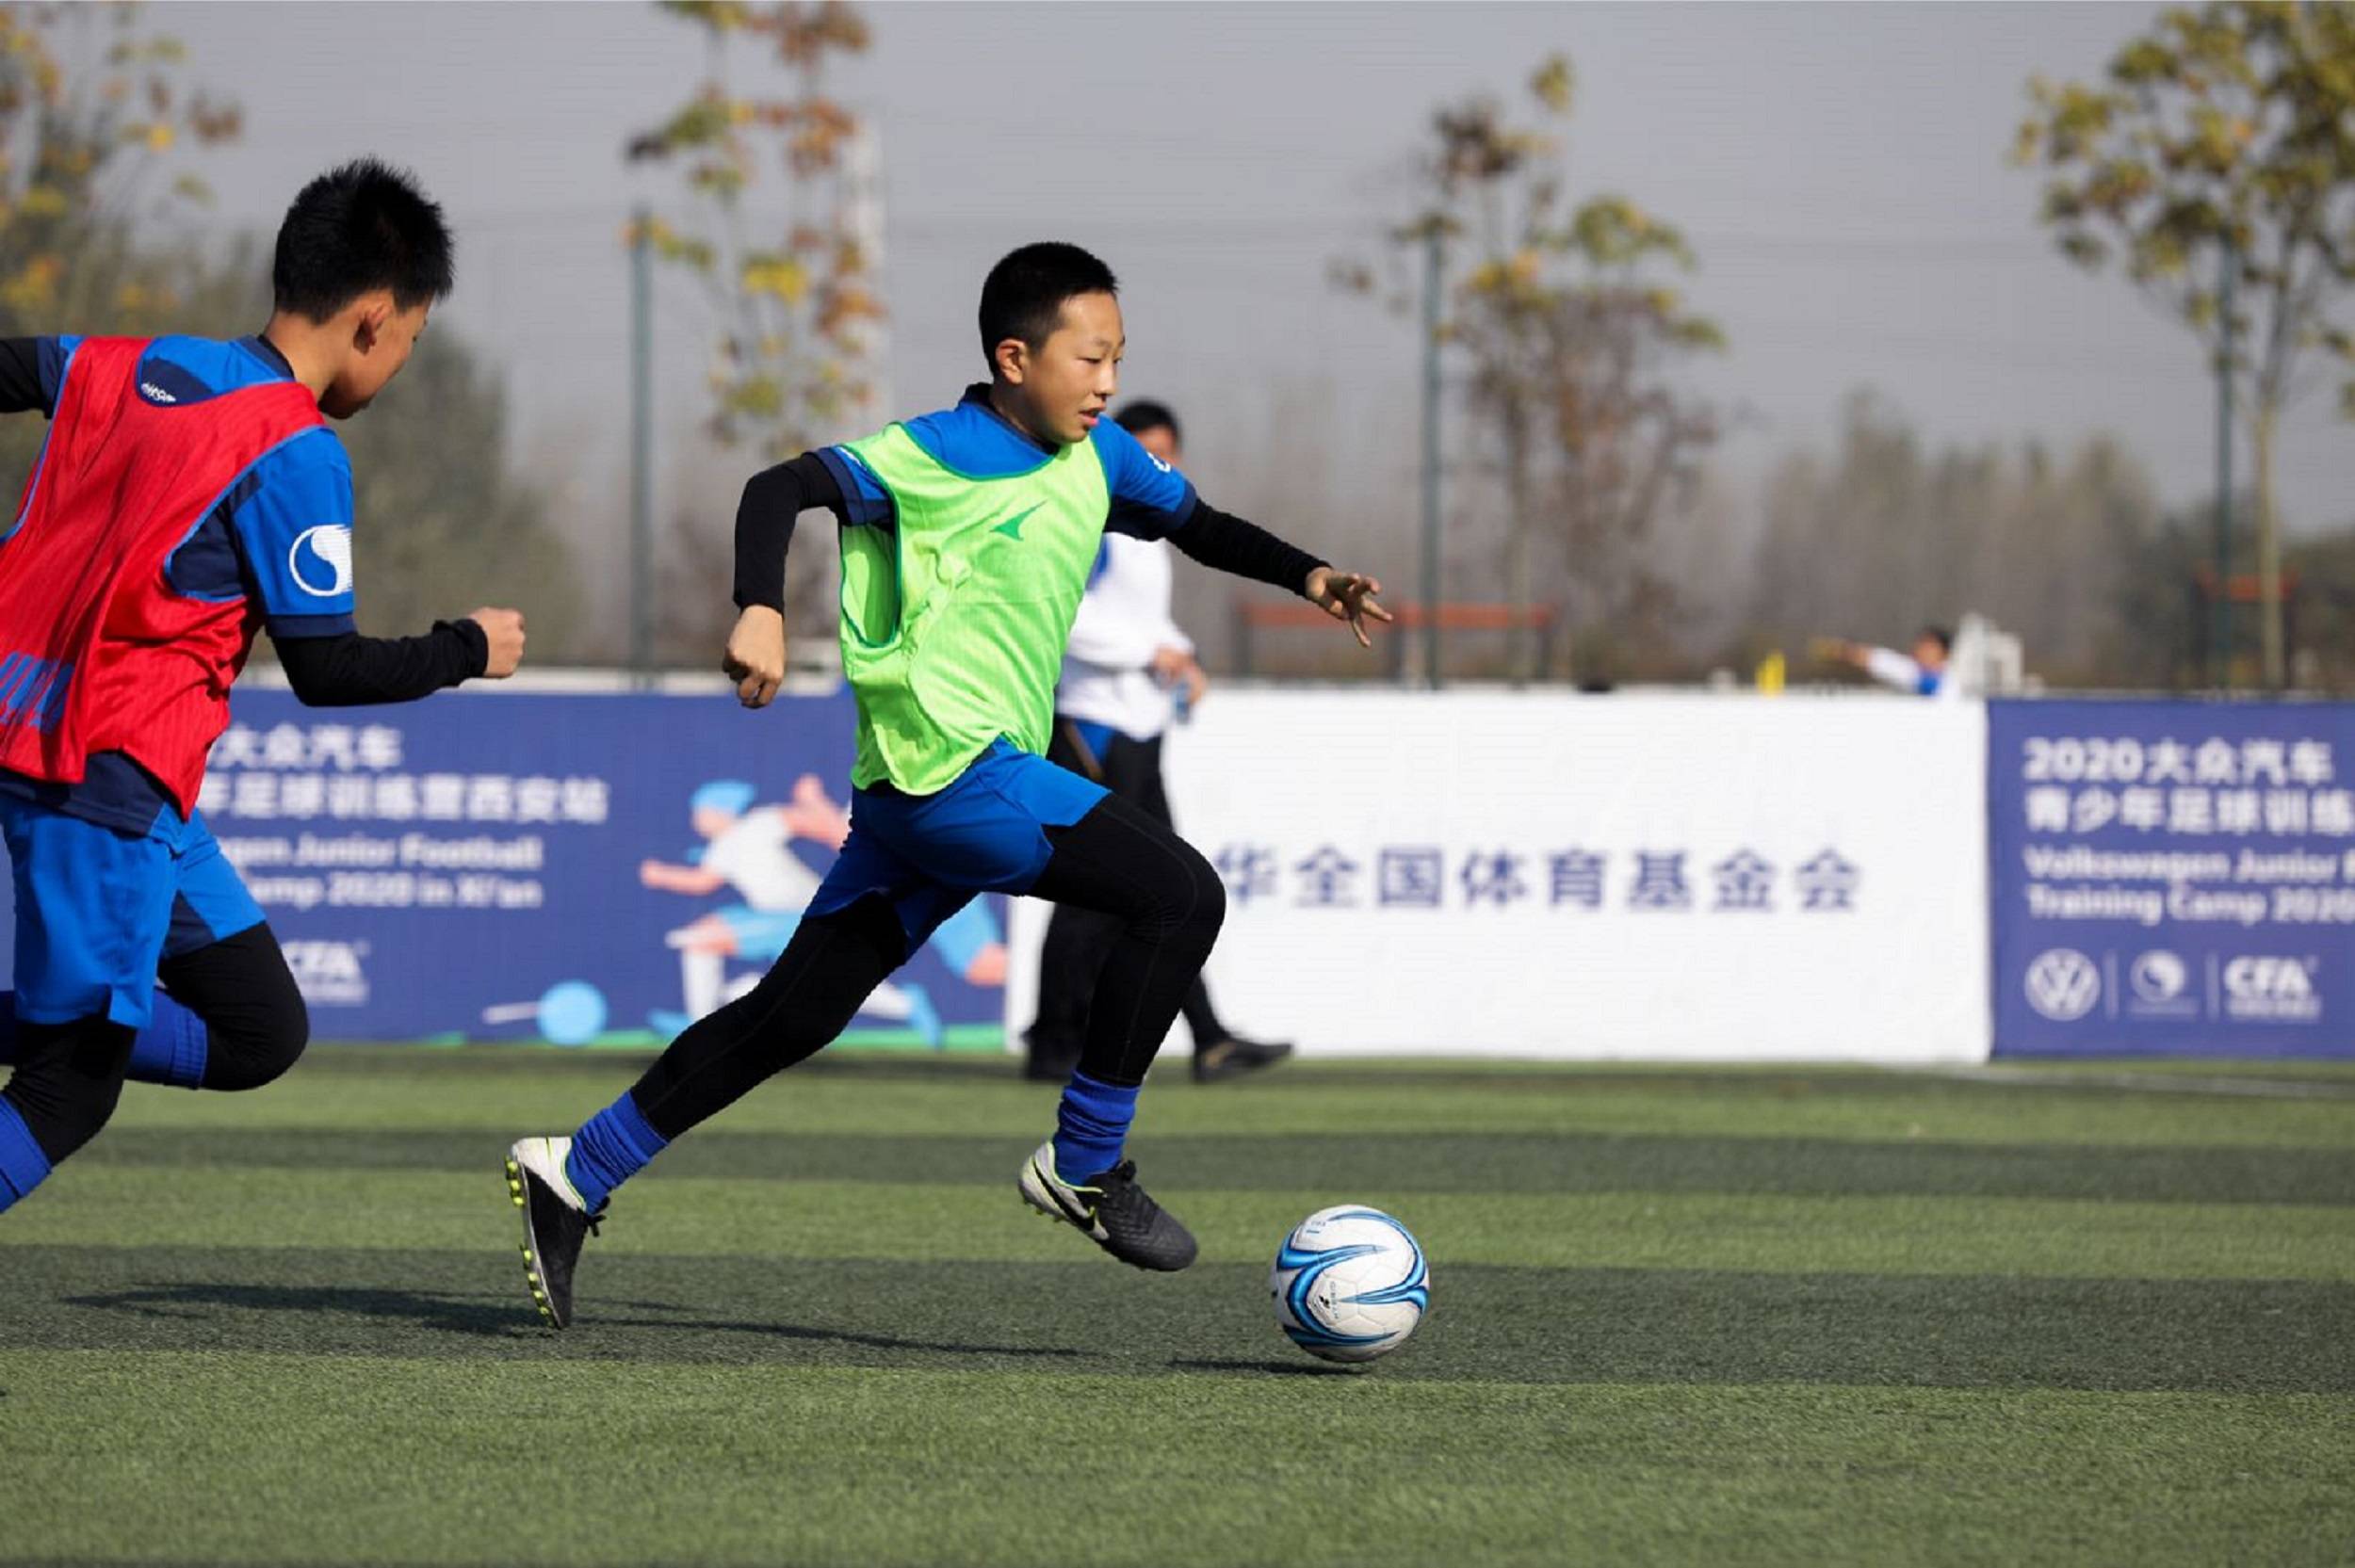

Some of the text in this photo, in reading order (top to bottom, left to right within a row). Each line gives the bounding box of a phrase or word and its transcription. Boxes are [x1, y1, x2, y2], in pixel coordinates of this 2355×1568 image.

[2024, 737, 2332, 784] 2020大众汽车
[296, 833, 397, 865] Junior
[400, 833, 544, 868] Football
[2236, 849, 2338, 883] Junior
[245, 874, 324, 912] amp
[329, 872, 414, 906] 2020
[1216, 845, 1860, 910] 华全国体育基金会
[2168, 887, 2266, 926] Camp
[2224, 954, 2314, 997] CFA
